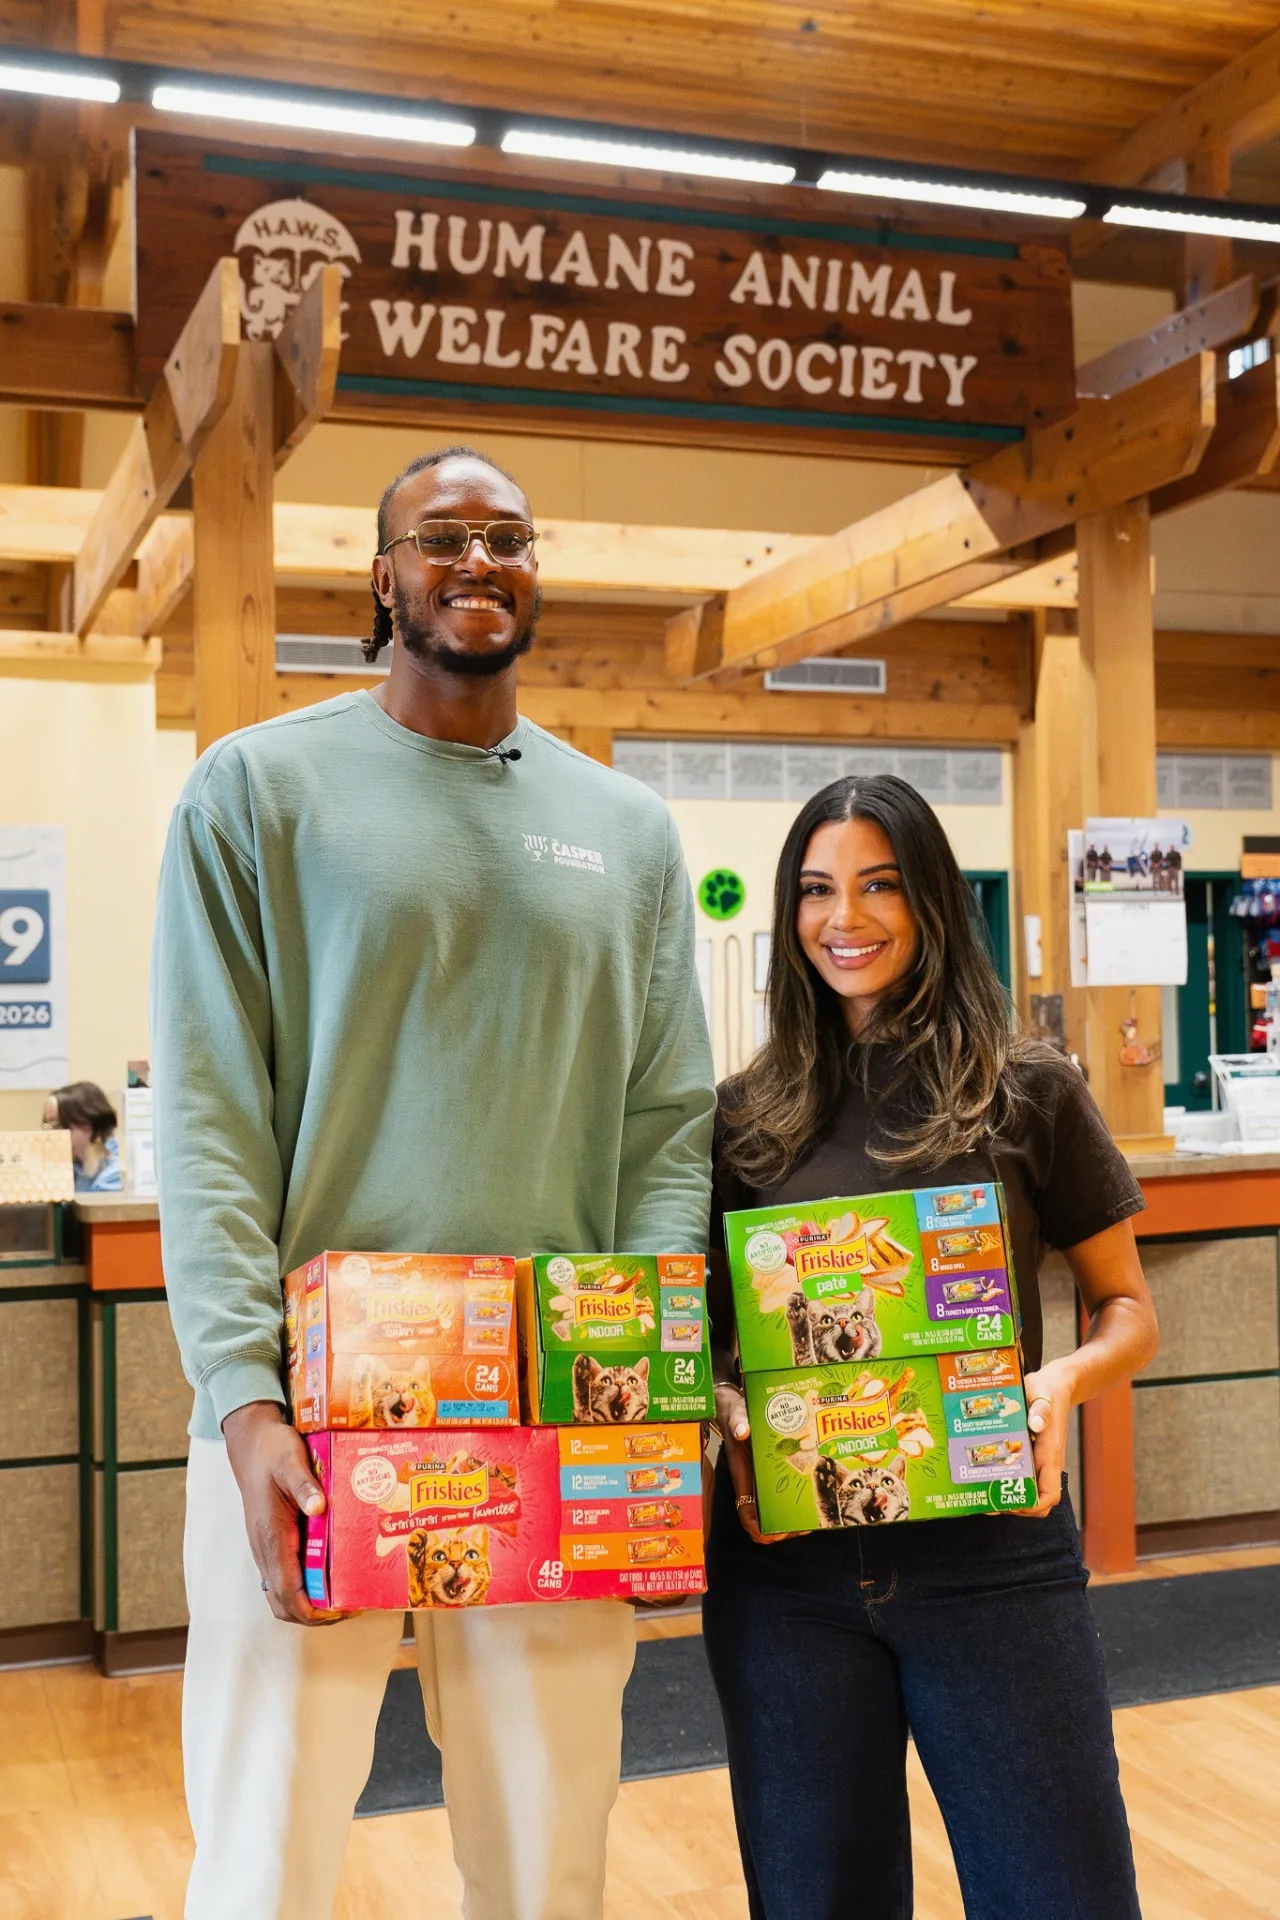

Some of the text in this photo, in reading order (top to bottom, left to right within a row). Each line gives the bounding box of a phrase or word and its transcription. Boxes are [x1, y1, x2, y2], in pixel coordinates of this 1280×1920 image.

[391, 209, 972, 325] HUMANE ANIMAL
[370, 299, 978, 406] WELFARE SOCIETY
[551, 843, 604, 866] CASPER
[553, 855, 605, 875] FOUNDATION
[926, 1215, 934, 1229] 8
[799, 1234, 826, 1243] PURINA
[800, 1249, 864, 1273] Friskies
[930, 1257, 939, 1272] 8
[373, 1299, 431, 1317] Friskies
[579, 1299, 631, 1317] Friskies
[935, 1303, 945, 1318] 8
[976, 1313, 1003, 1332] 24
[588, 1325, 625, 1339] INDOOR
[976, 1331, 1003, 1341] CANS
[475, 1364, 500, 1384] 24
[674, 1358, 696, 1376] 24
[474, 1382, 499, 1393] CANS
[673, 1375, 695, 1386] CANS
[948, 1375, 956, 1390] 8
[780, 1402, 790, 1410] NO
[821, 1395, 848, 1404] PURINA
[771, 1404, 803, 1420] ARTIFICIAL
[821, 1411, 886, 1435] Friskies
[954, 1418, 962, 1433] 8
[570, 1439, 582, 1456] 12
[837, 1436, 879, 1455] INDOOR
[417, 1463, 446, 1471] PURINA
[959, 1465, 968, 1480] 8
[357, 1471, 391, 1486] ARTIFICIAL
[571, 1474, 583, 1490] 12
[1000, 1476, 1027, 1495] 24
[416, 1480, 483, 1504] Friskies
[1000, 1494, 1027, 1505] CANS
[572, 1508, 584, 1526] 12
[573, 1544, 584, 1560] 12
[538, 1559, 564, 1579] 48
[537, 1578, 562, 1589] CANS
